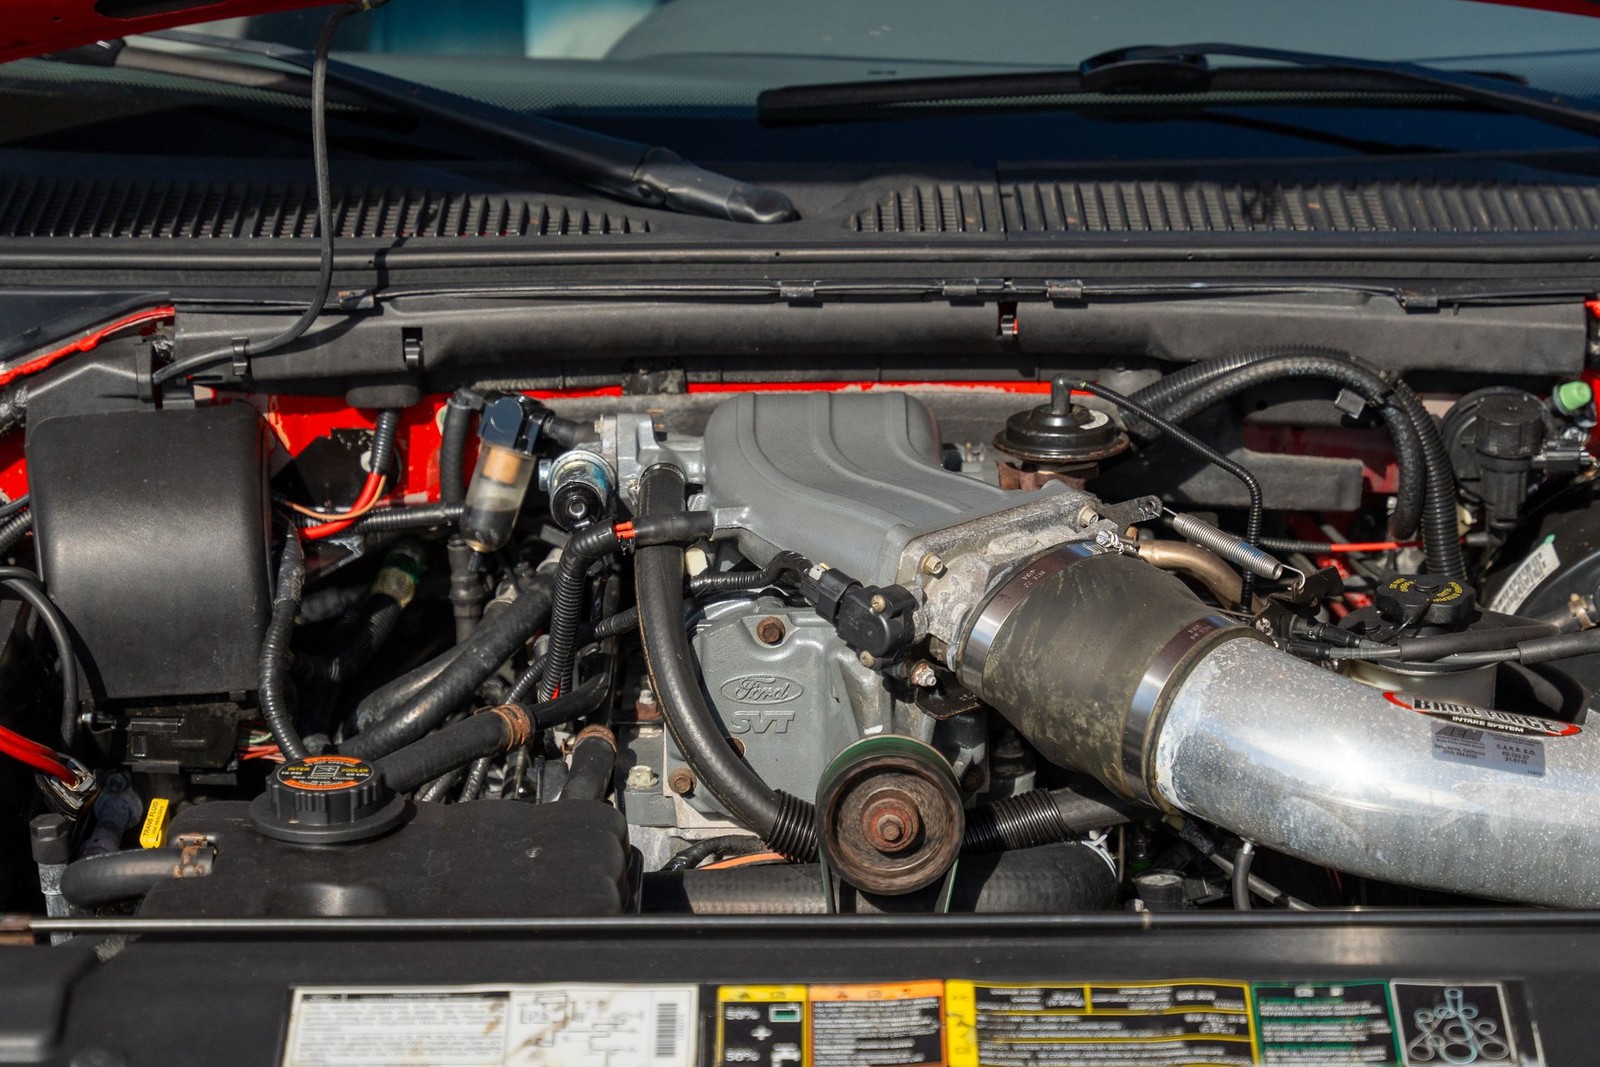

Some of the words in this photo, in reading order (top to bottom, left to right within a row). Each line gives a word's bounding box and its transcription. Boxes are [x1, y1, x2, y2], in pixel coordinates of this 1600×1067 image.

[733, 677, 790, 700] Ford
[730, 710, 795, 734] SVT
[1452, 715, 1486, 726] INTAKE
[1487, 722, 1524, 733] SYSTEM
[1434, 725, 1484, 742] AEM
[143, 818, 154, 836] TRANS
[149, 801, 159, 817] FLUID
[724, 1007, 761, 1020] 50%
[724, 1048, 761, 1062] 50%
